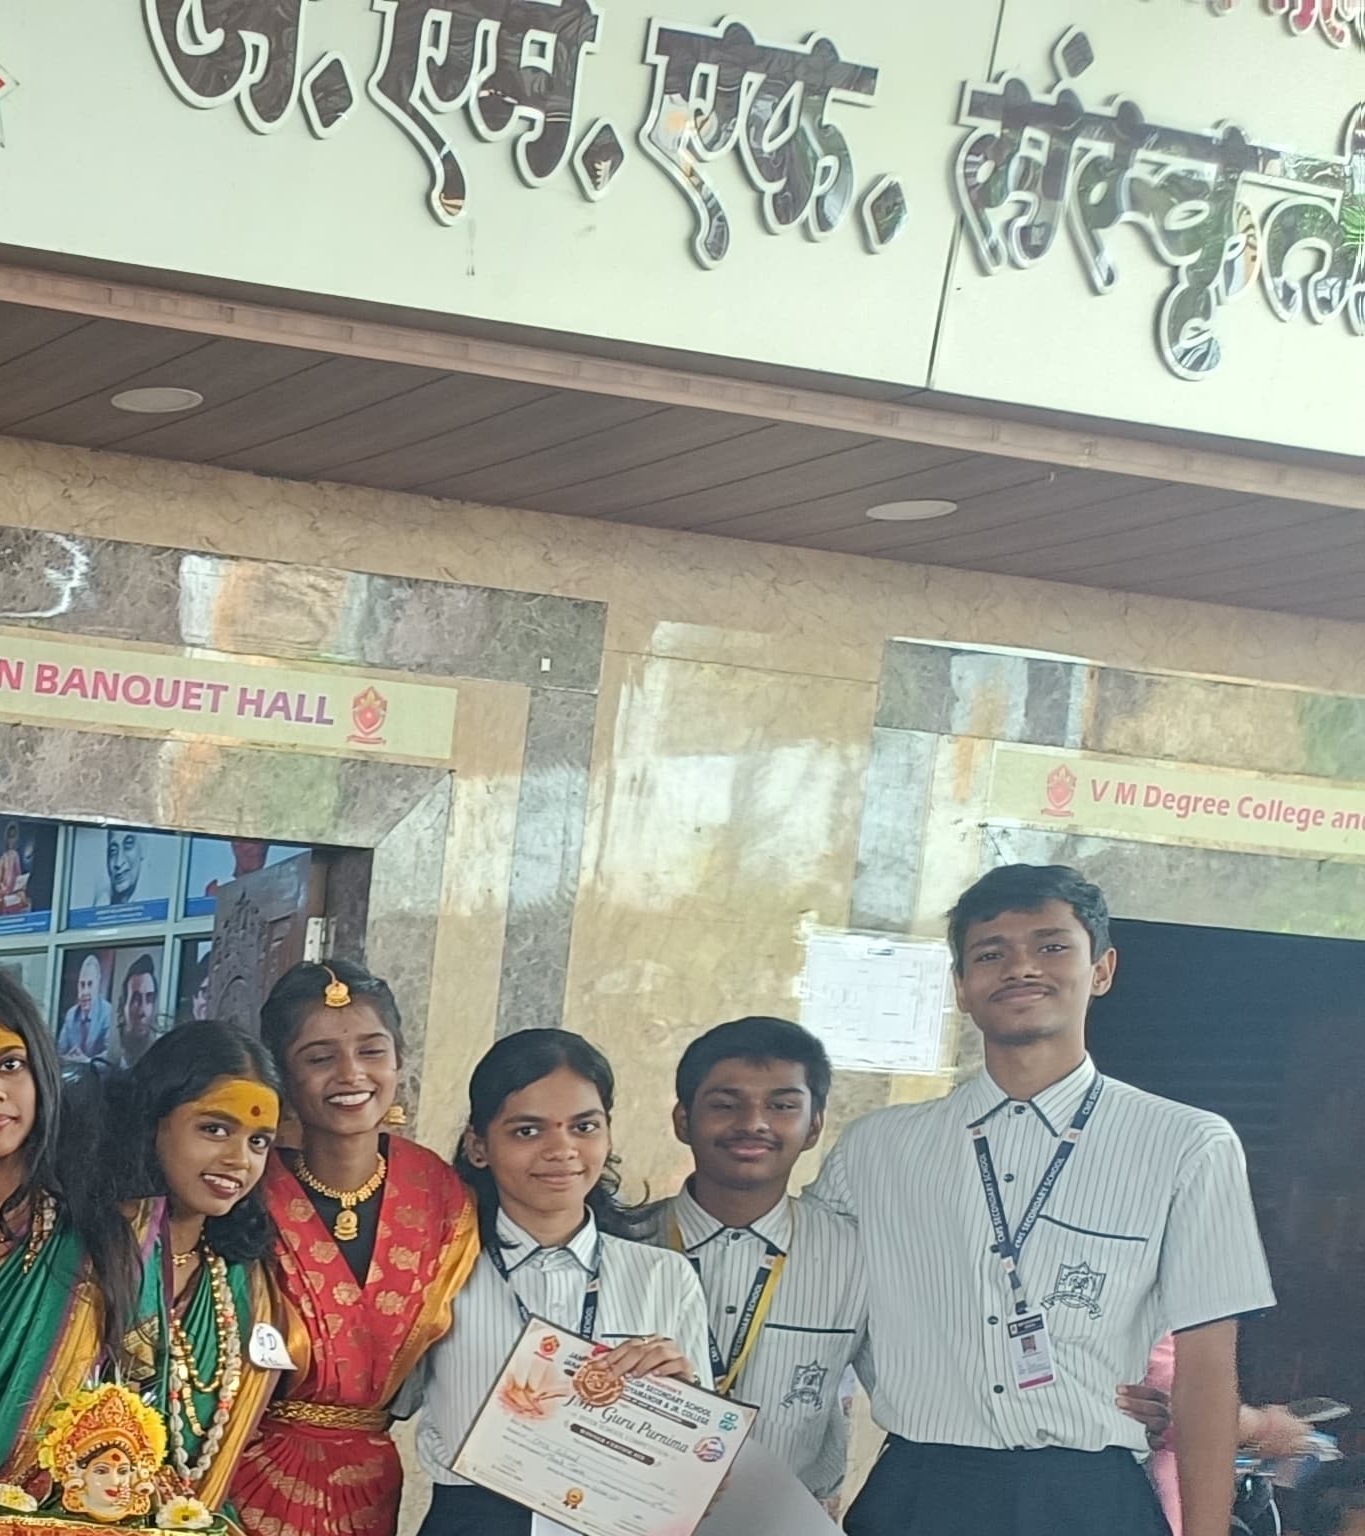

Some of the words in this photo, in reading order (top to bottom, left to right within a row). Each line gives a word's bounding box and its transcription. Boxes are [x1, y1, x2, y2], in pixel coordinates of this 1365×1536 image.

[34, 663, 229, 714] BANQUET
[236, 687, 335, 726] HALL
[1091, 779, 1109, 802] V
[1115, 782, 1137, 805] M
[1143, 785, 1230, 819] Degree
[1237, 796, 1326, 832] College
[1018, 1185, 1051, 1232] SECONDARY
[1041, 1155, 1065, 1187] SCHOOL
[598, 1403, 639, 1436] Guru
[636, 1419, 691, 1454] Purnima
